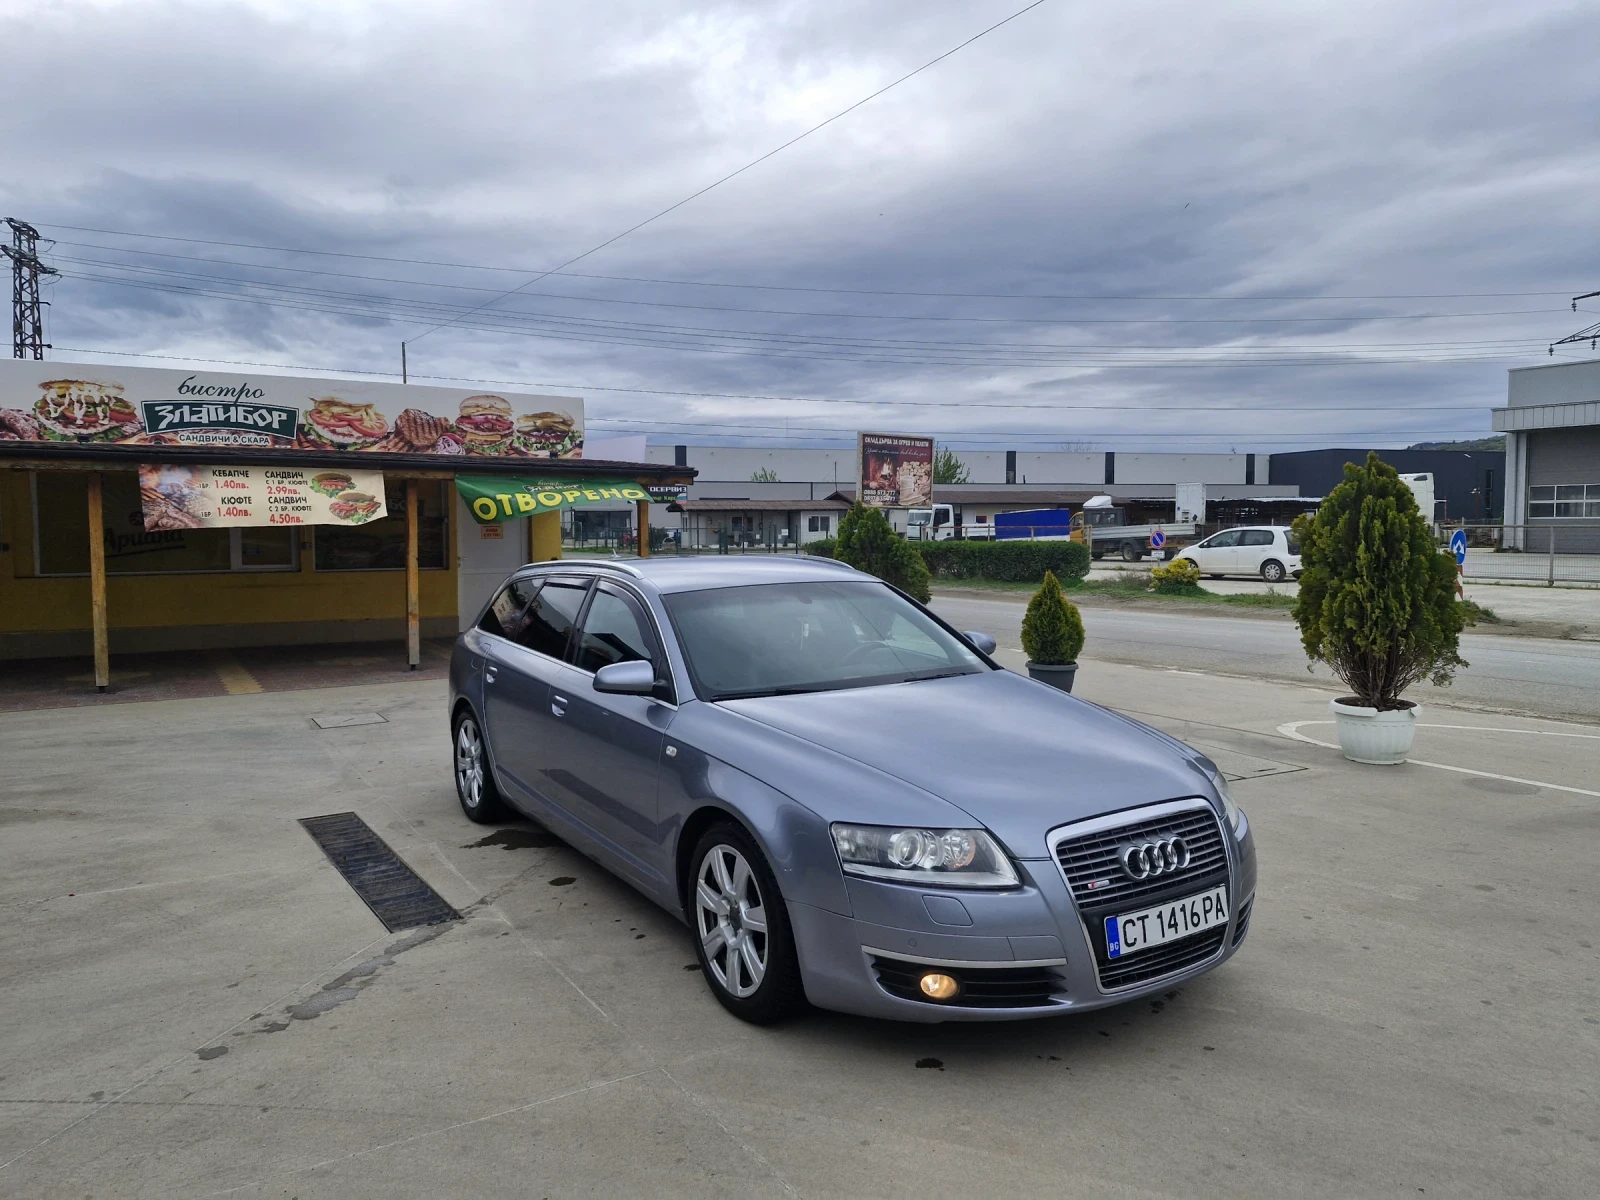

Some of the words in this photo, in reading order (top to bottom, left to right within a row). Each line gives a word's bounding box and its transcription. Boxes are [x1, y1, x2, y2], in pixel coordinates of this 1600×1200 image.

[178, 375, 265, 404] бистро
[154, 404, 288, 430] ЗЛАТИБОР
[179, 434, 232, 443] САНДВИЧИ
[241, 436, 270, 444] СКАРА
[212, 469, 250, 478] КЕБАПЧЕ
[264, 470, 304, 479] САНДВИЧ
[215, 480, 249, 489] 1.40лв.
[266, 486, 301, 495] 2.99лв.
[221, 496, 252, 505] КЮФТЕ
[268, 496, 307, 504] САНДВИЧ
[473, 488, 645, 521] ОТВОРЕНО
[217, 507, 252, 517] 1.40лв.
[269, 513, 304, 524] 4.50лв.
[1122, 914, 1149, 948] CT
[1109, 941, 1119, 952] BG
